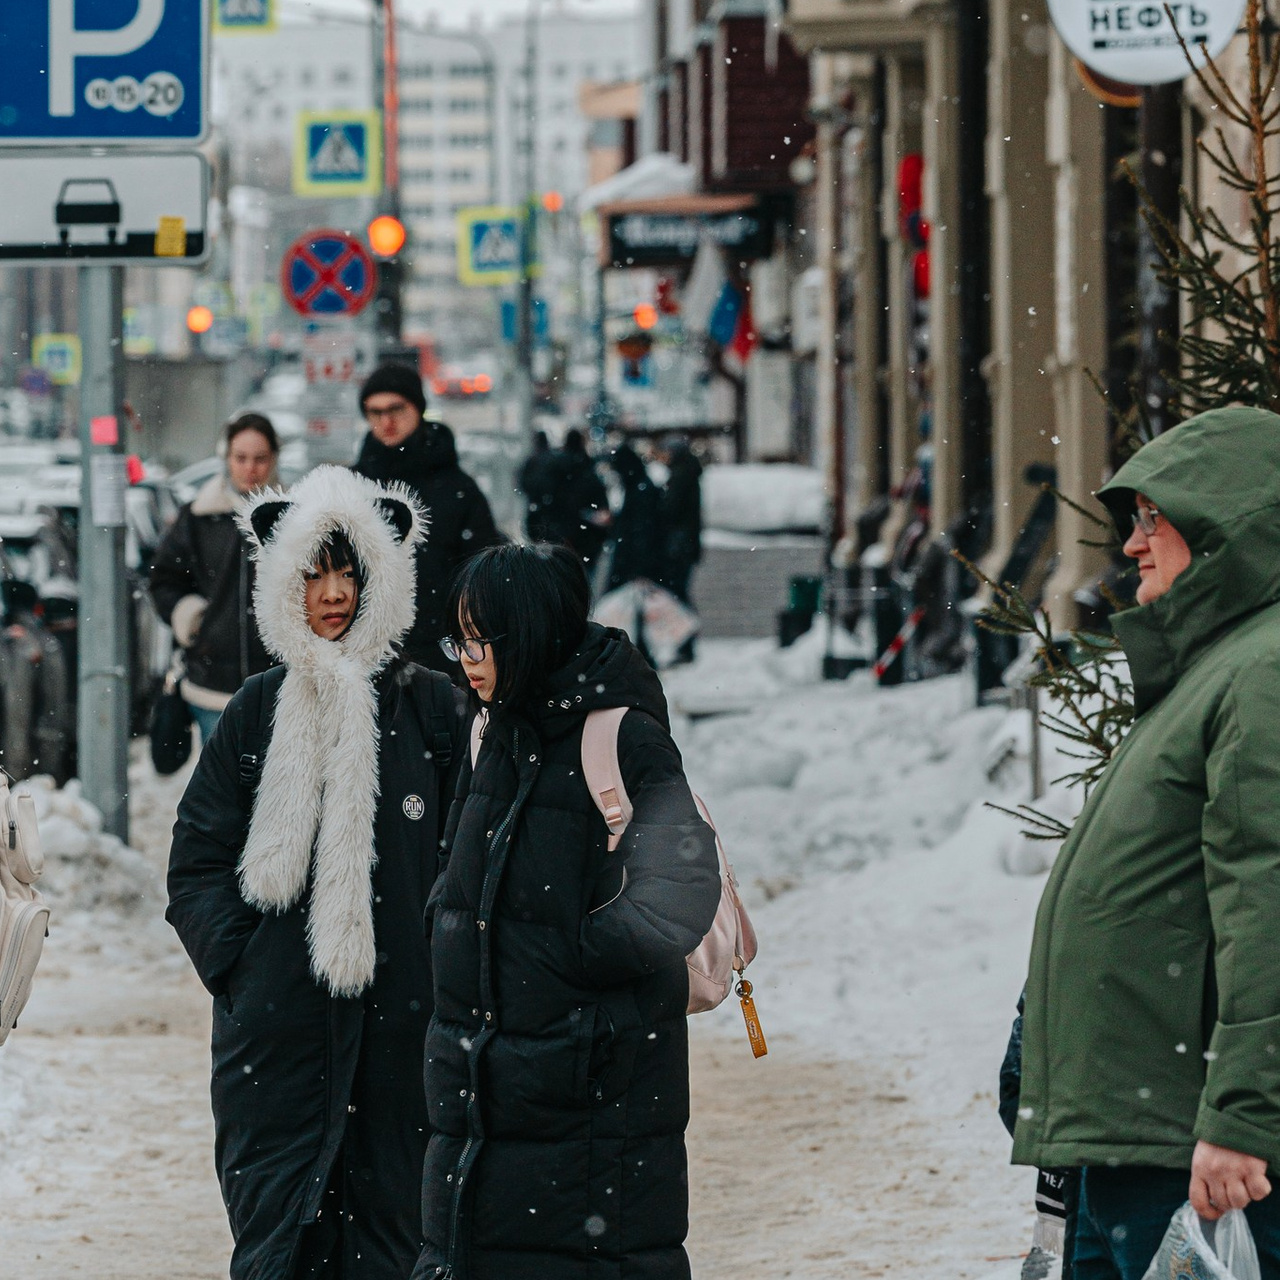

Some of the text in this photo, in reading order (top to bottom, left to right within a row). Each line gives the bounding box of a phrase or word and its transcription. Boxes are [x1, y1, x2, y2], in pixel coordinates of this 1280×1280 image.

[1090, 4, 1208, 31] НЕФТЬ
[146, 81, 180, 107] 20
[405, 801, 422, 812] RUN
